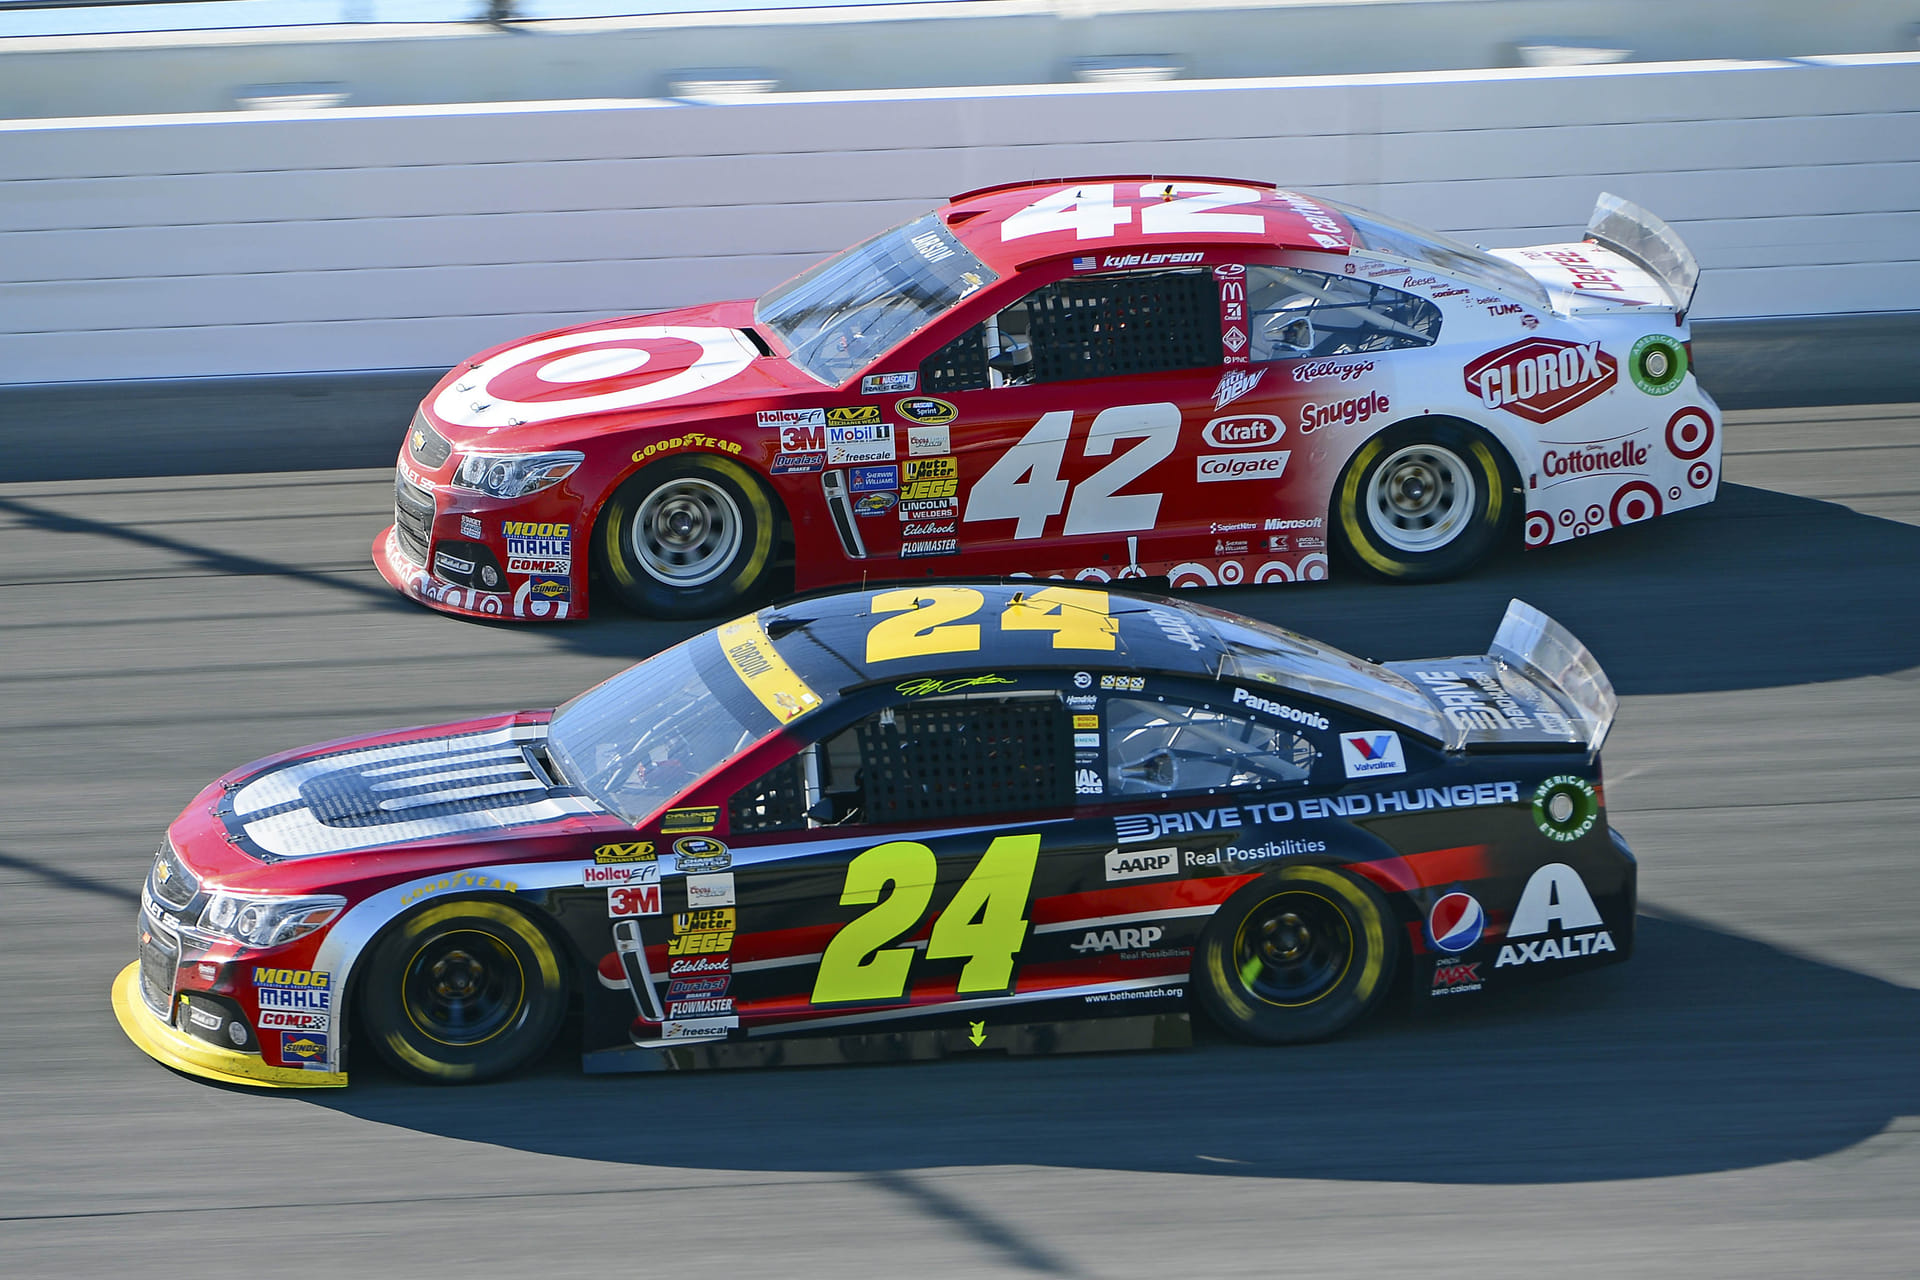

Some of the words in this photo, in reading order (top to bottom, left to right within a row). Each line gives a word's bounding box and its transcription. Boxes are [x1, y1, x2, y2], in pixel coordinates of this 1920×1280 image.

[1001, 183, 1265, 242] 42
[912, 230, 956, 263] LARSON
[1141, 252, 1204, 265] Larson
[1432, 288, 1470, 298] sonicare
[1487, 304, 1523, 316] TUMS
[1633, 335, 1681, 354] AMERICAN
[882, 374, 908, 383] NASCAR
[1293, 360, 1374, 381] Kellogg's
[1480, 341, 1603, 409] CLOROX
[1637, 379, 1681, 394] ETHANOL
[758, 411, 800, 424] Holley
[1301, 390, 1390, 434] Snuggle
[783, 426, 826, 452] 3M
[830, 426, 873, 441] Mobil
[1220, 421, 1267, 441] Kraft
[631, 433, 743, 462] GOODYEAR
[845, 450, 891, 461] freescale
[776, 454, 822, 466] Duralast
[920, 460, 947, 468] Auto
[1201, 458, 1279, 476] Colgate
[1543, 440, 1648, 478] Cottonelle
[916, 467, 954, 479] Meter
[963, 402, 1182, 540] 42
[900, 479, 958, 500] JEGS
[902, 501, 948, 511] LINCOLN
[912, 509, 953, 519] WELDERS
[502, 521, 570, 537] MOOG
[903, 521, 955, 536] Edelbrock
[1264, 517, 1322, 530] Microsoft
[508, 539, 570, 555] MAHLE
[901, 539, 957, 557] FLOWMASTER
[511, 559, 556, 571] COMP
[533, 585, 568, 593] SUNOCO
[866, 586, 1119, 663] 24
[1233, 687, 1329, 731] Panasonic
[1415, 671, 1513, 730] DRIVE
[1496, 700, 1526, 717] END
[1354, 760, 1396, 771] Valvoline
[1534, 775, 1595, 808] AMERICAN
[1113, 807, 1242, 844] DRIVE
[1244, 801, 1295, 824] TO
[1300, 795, 1372, 820] END
[1378, 780, 1519, 813] HUNGER
[1538, 814, 1597, 841] ETHANOL
[1112, 855, 1170, 874] AARP
[1184, 851, 1221, 867] Real
[1226, 838, 1326, 862] Possibilities
[585, 867, 631, 883] Holley
[401, 872, 519, 905] GOODYEAR
[611, 886, 659, 915] 3M
[692, 910, 724, 920] Auto
[810, 833, 1041, 1004] 24
[690, 919, 731, 931] Meter
[668, 932, 735, 955] JEGS
[1070, 926, 1162, 953] AARP
[1120, 952, 1139, 960] Real
[1141, 948, 1190, 959] Possibilities
[1494, 931, 1616, 968] AXALTA
[671, 957, 729, 974] Edelbrock
[254, 967, 329, 987] MOOG
[1433, 962, 1482, 987] MAX
[673, 979, 725, 992] Duralast
[1432, 987, 1449, 996] zero
[1450, 983, 1482, 993] calories
[260, 988, 329, 1009] MAHLE
[1085, 987, 1184, 1002] www.bethematch.org
[670, 998, 733, 1019] FLOWMASTER
[263, 1012, 313, 1026] COMP
[285, 1044, 326, 1053] SUNOCO
